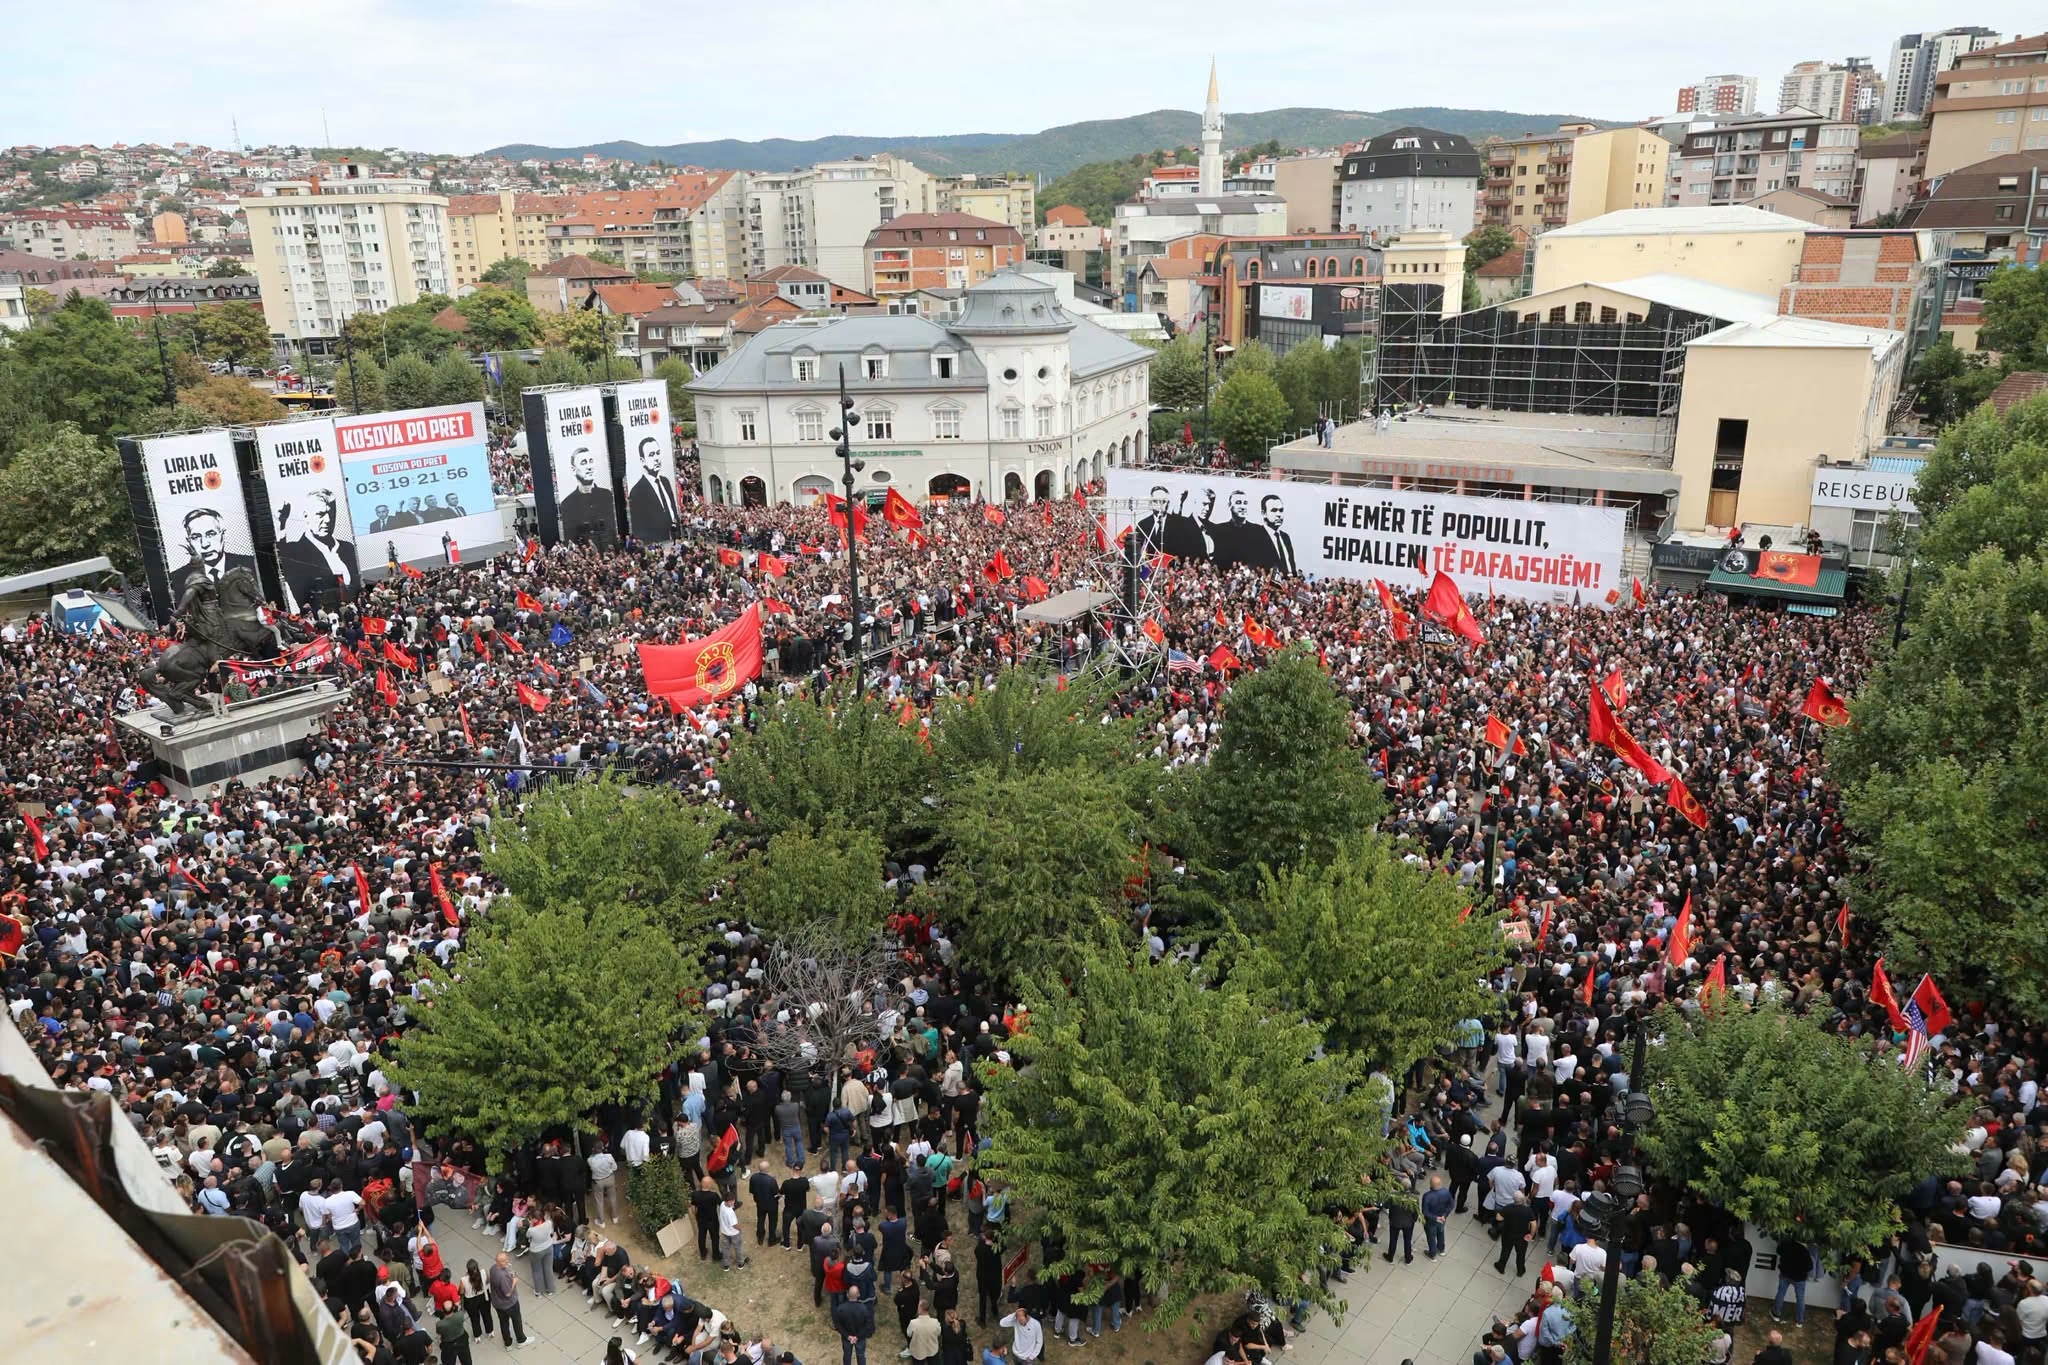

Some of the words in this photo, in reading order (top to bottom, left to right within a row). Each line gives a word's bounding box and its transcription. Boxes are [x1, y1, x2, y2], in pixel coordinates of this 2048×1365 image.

[559, 407, 580, 421] LIRIA
[581, 406, 592, 417] KA
[628, 399, 648, 411] LIRIA
[649, 397, 658, 408] KA
[561, 421, 582, 437] EMËR
[630, 412, 649, 427] EMËR
[342, 426, 402, 451] KOSOVA
[407, 422, 427, 440] PO
[429, 415, 465, 438] PRET
[274, 440, 304, 458] LIRIA
[305, 438, 322, 454] KA
[1028, 441, 1063, 453] UNION
[164, 456, 198, 474] LIRIA
[200, 453, 217, 470] KA
[278, 459, 309, 478] EMËR
[377, 461, 409, 473] KOSOVA
[411, 460, 422, 469] PO
[423, 456, 443, 468] PRET
[169, 474, 203, 496] EMËR
[1324, 498, 1349, 527] NË
[1351, 501, 1405, 533] EMËR
[1411, 504, 1434, 535] TË
[1441, 510, 1549, 550] POPULLIT,
[1322, 536, 1428, 570] SHPALLENI
[1433, 542, 1456, 573] TË
[1459, 554, 1601, 589] PAFAJSHËM!
[242, 670, 273, 681] LIRIA
[275, 666, 293, 674] KA
[295, 655, 325, 670] EMËR
